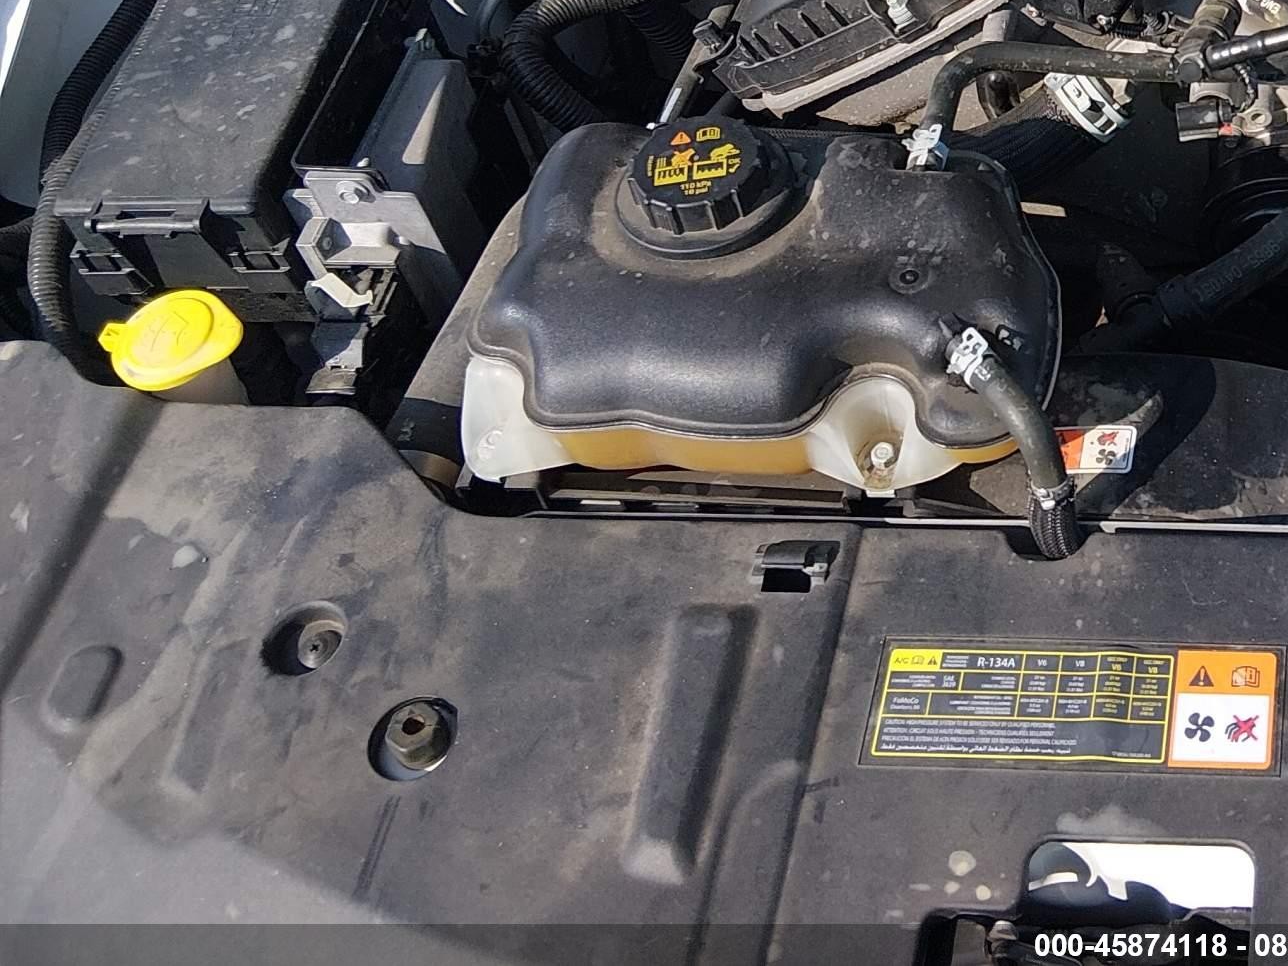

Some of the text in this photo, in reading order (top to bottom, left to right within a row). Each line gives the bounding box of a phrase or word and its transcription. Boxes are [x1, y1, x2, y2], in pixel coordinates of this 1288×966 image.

[680, 183, 695, 191] 110
[977, 657, 1015, 668] R-134A
[1037, 659, 1047, 667] V6
[1075, 659, 1086, 667] V8
